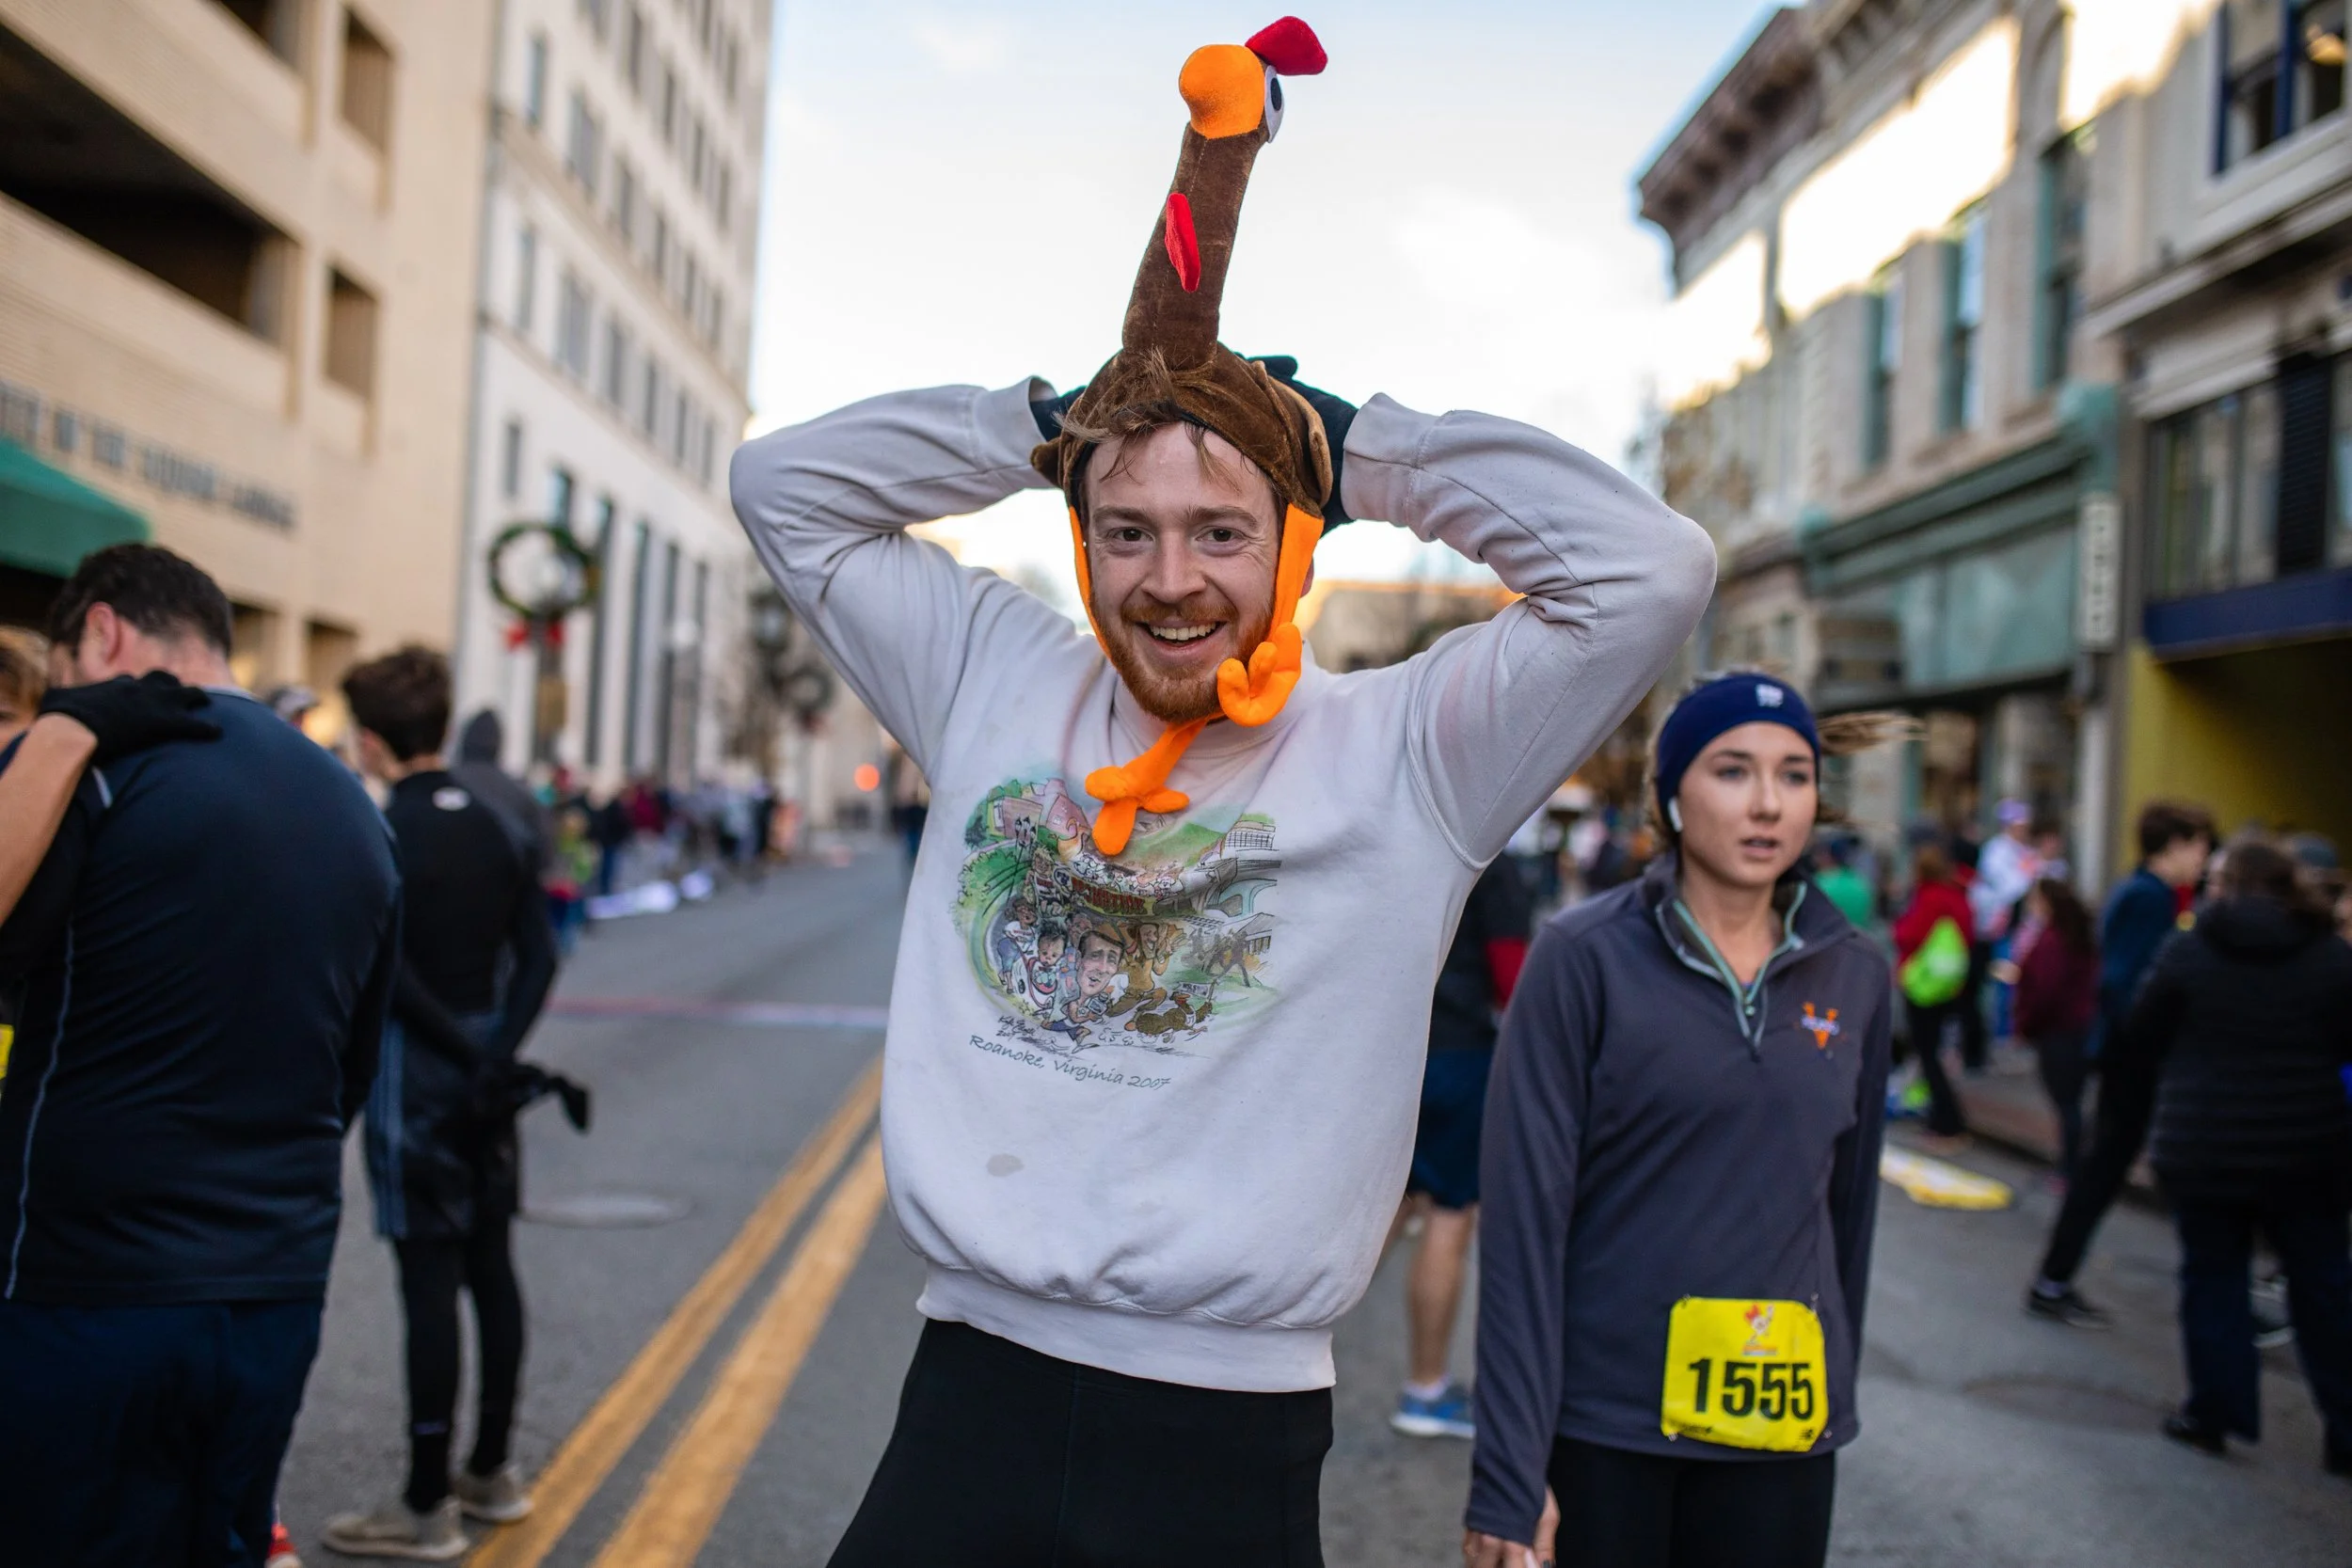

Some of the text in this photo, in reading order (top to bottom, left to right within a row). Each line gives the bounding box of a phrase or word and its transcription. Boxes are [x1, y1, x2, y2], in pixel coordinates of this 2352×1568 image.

[969, 1035, 1171, 1090] Roanoke, Virginia 2007
[1689, 1357, 1815, 1421] 1555
